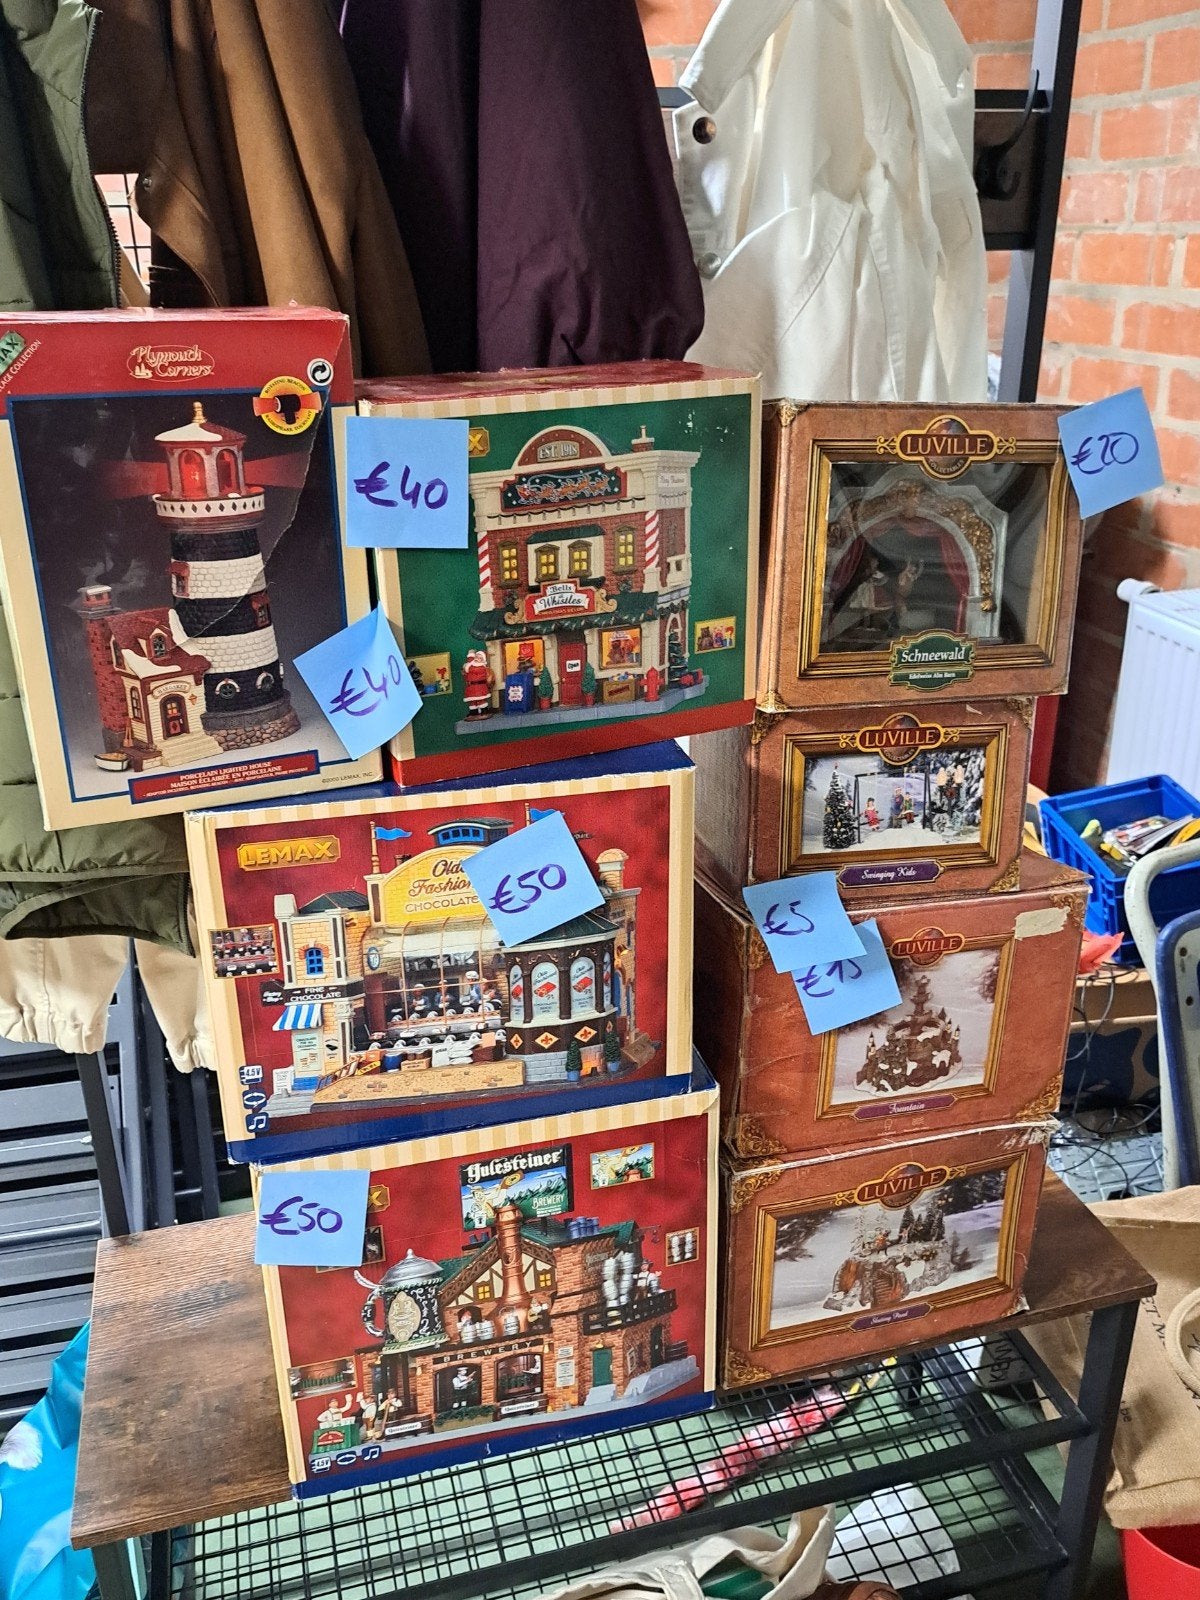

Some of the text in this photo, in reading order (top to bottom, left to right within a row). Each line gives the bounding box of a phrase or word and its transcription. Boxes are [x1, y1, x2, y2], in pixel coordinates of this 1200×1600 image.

[0, 337, 20, 363] AX
[9, 338, 42, 375] COLLECTION
[130, 344, 203, 368] Plymouth
[155, 361, 212, 377] Corners
[906, 436, 989, 455] LUVILLE
[353, 461, 449, 510] €40
[549, 584, 573, 594] Bells
[539, 594, 583, 609] Whistles
[901, 646, 966, 663] Schneewald
[328, 654, 401, 717] €40
[864, 729, 936, 747] LUVILLE
[170, 779, 198, 789] MAISON
[231, 771, 242, 779] EN
[241, 765, 283, 777] PORCELAINE
[180, 761, 273, 781] PORCELAIN LIGHTED HOUSE
[240, 841, 335, 867] LEMAX
[861, 866, 917, 881] Swinging Kids
[488, 863, 568, 914] €50
[762, 899, 815, 936] €5
[897, 937, 959, 955] LUVILLE
[289, 991, 342, 1002] CHOCOLATE
[304, 986, 325, 994] FINE
[888, 1102, 926, 1114] Fountain
[863, 1170, 942, 1200] LUVILLE
[532, 1194, 564, 1210] BREWERY
[258, 1195, 343, 1236] €50
[443, 1341, 532, 1363] BREWERY
